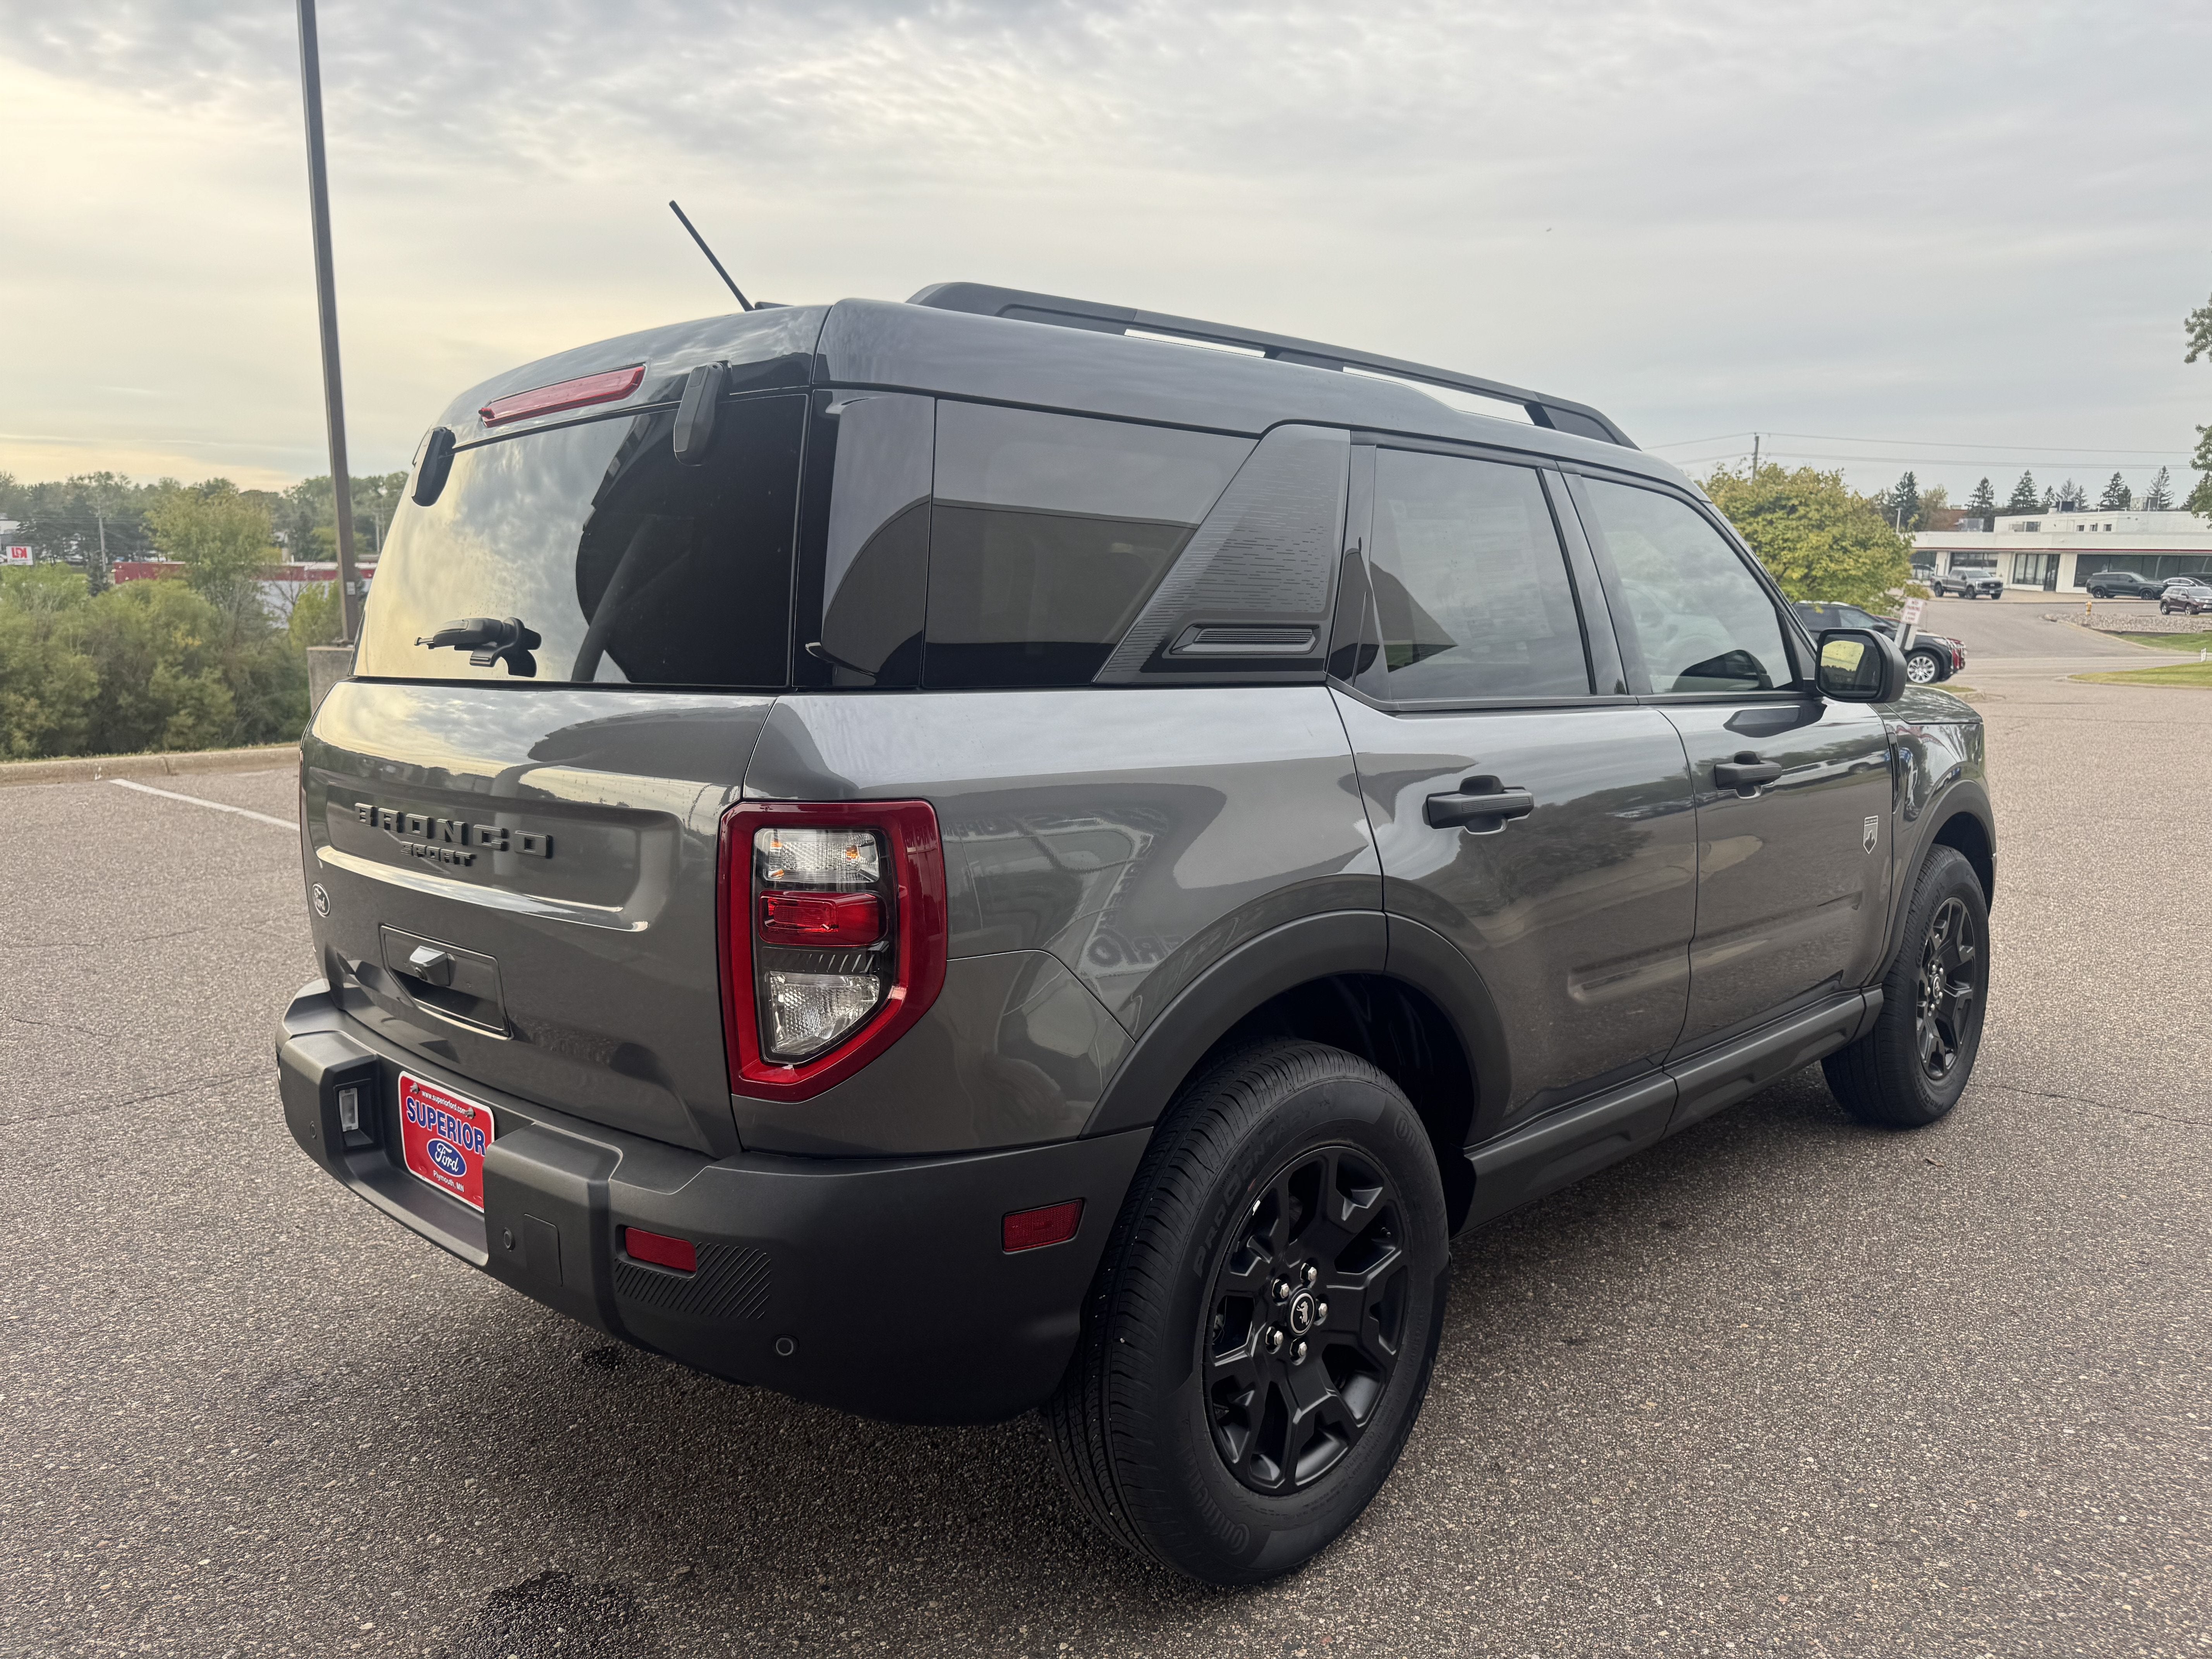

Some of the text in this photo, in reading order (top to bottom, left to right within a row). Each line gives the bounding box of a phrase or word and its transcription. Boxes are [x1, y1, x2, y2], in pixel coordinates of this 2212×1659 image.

[355, 803, 552, 859] BRONCO
[400, 841, 476, 866] SPORT
[421, 1091, 466, 1115] www.superiorford.com
[406, 1096, 485, 1157] SUPERIOR
[435, 1143, 459, 1172] Ford
[433, 1170, 464, 1192] Plymouth, MN
